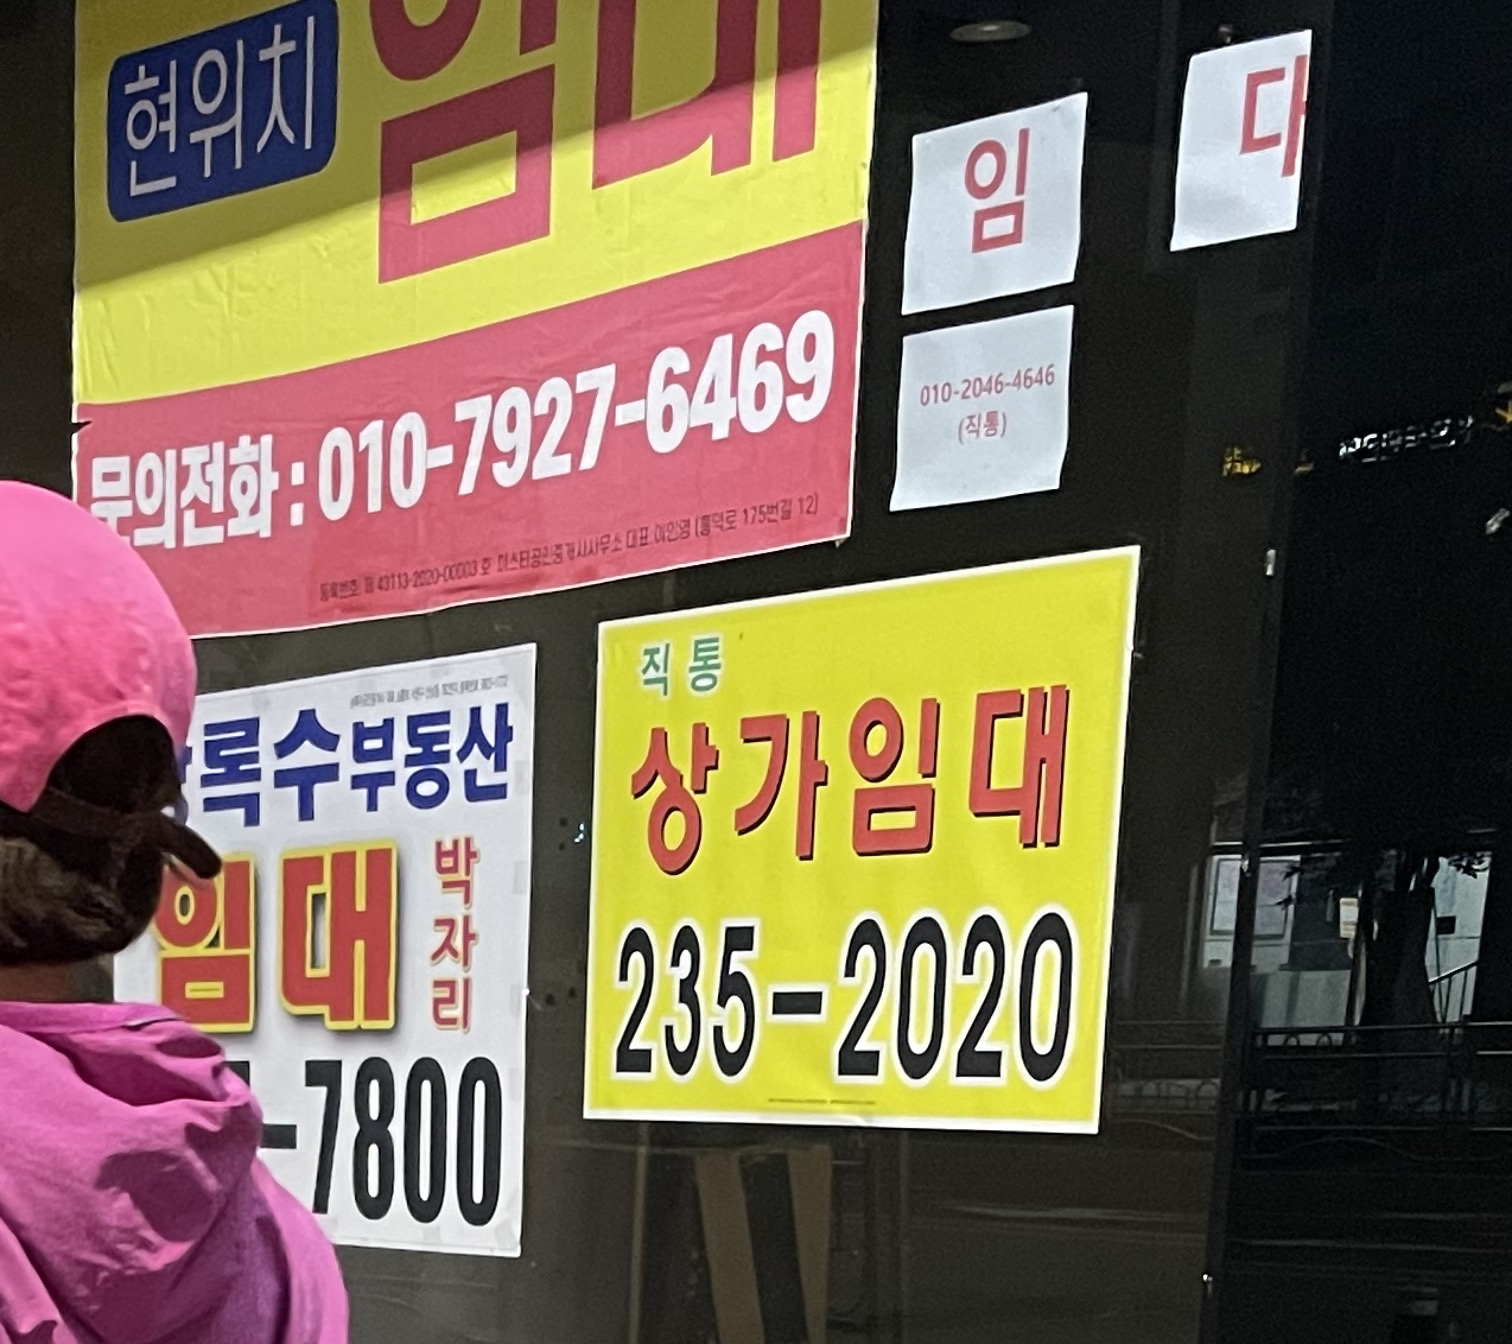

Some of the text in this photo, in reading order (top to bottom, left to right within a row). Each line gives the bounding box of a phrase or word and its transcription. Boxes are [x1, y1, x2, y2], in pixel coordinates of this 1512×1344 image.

[124, 15, 316, 198] 현위치
[963, 127, 1031, 254] 임
[919, 363, 1056, 408] 010-2046-4646
[957, 411, 1008, 444] (직통)
[630, 683, 1071, 877] 상가임대
[154, 841, 400, 1035] 임대
[615, 910, 1075, 1084] 235-2020
